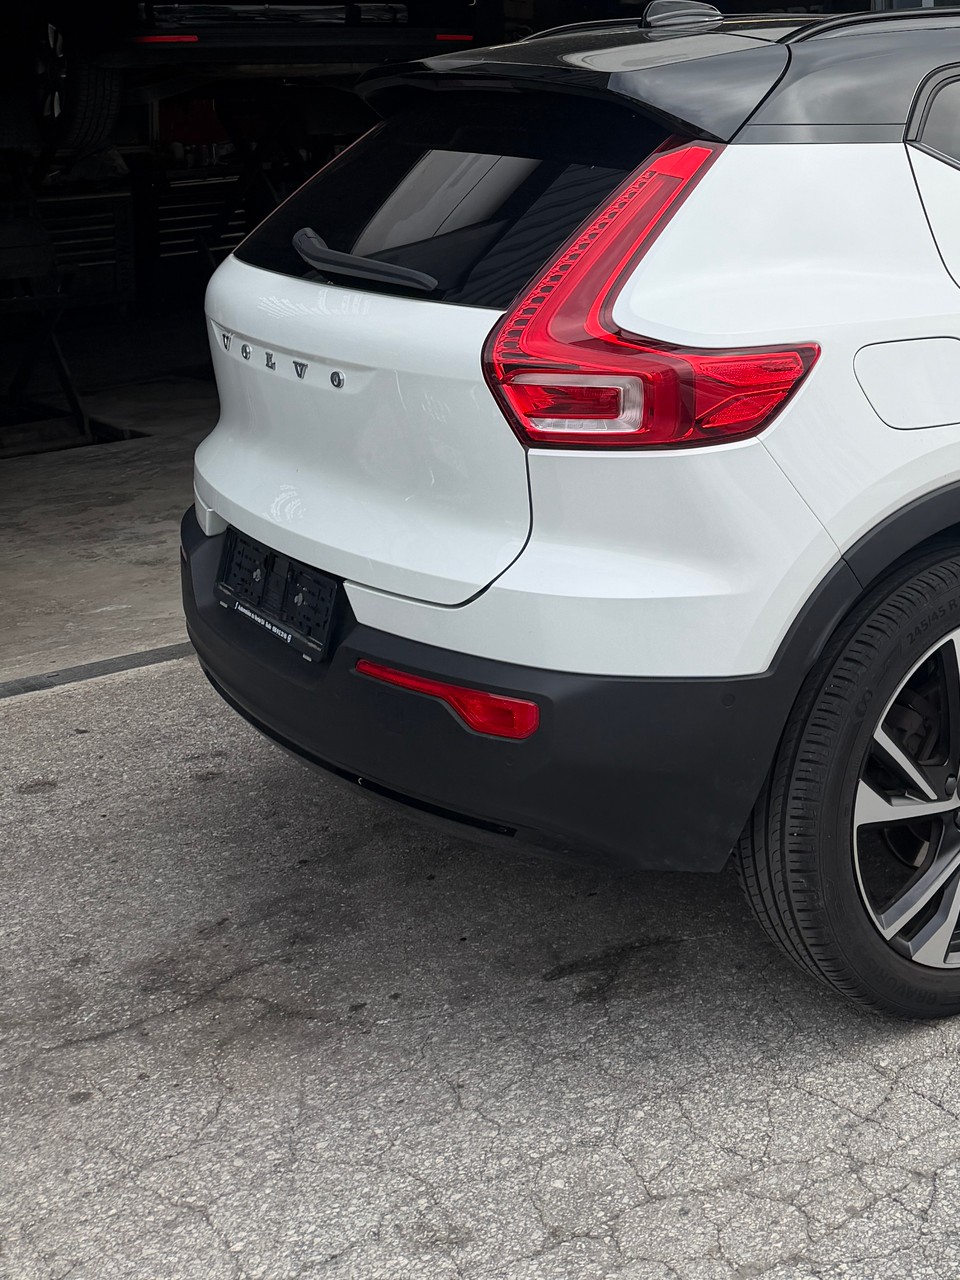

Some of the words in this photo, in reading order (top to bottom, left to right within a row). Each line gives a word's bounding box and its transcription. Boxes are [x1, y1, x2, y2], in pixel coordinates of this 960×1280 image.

[222, 333, 345, 389] VOLVO
[906, 606, 946, 645] 245/45
[948, 599, 958, 611] R
